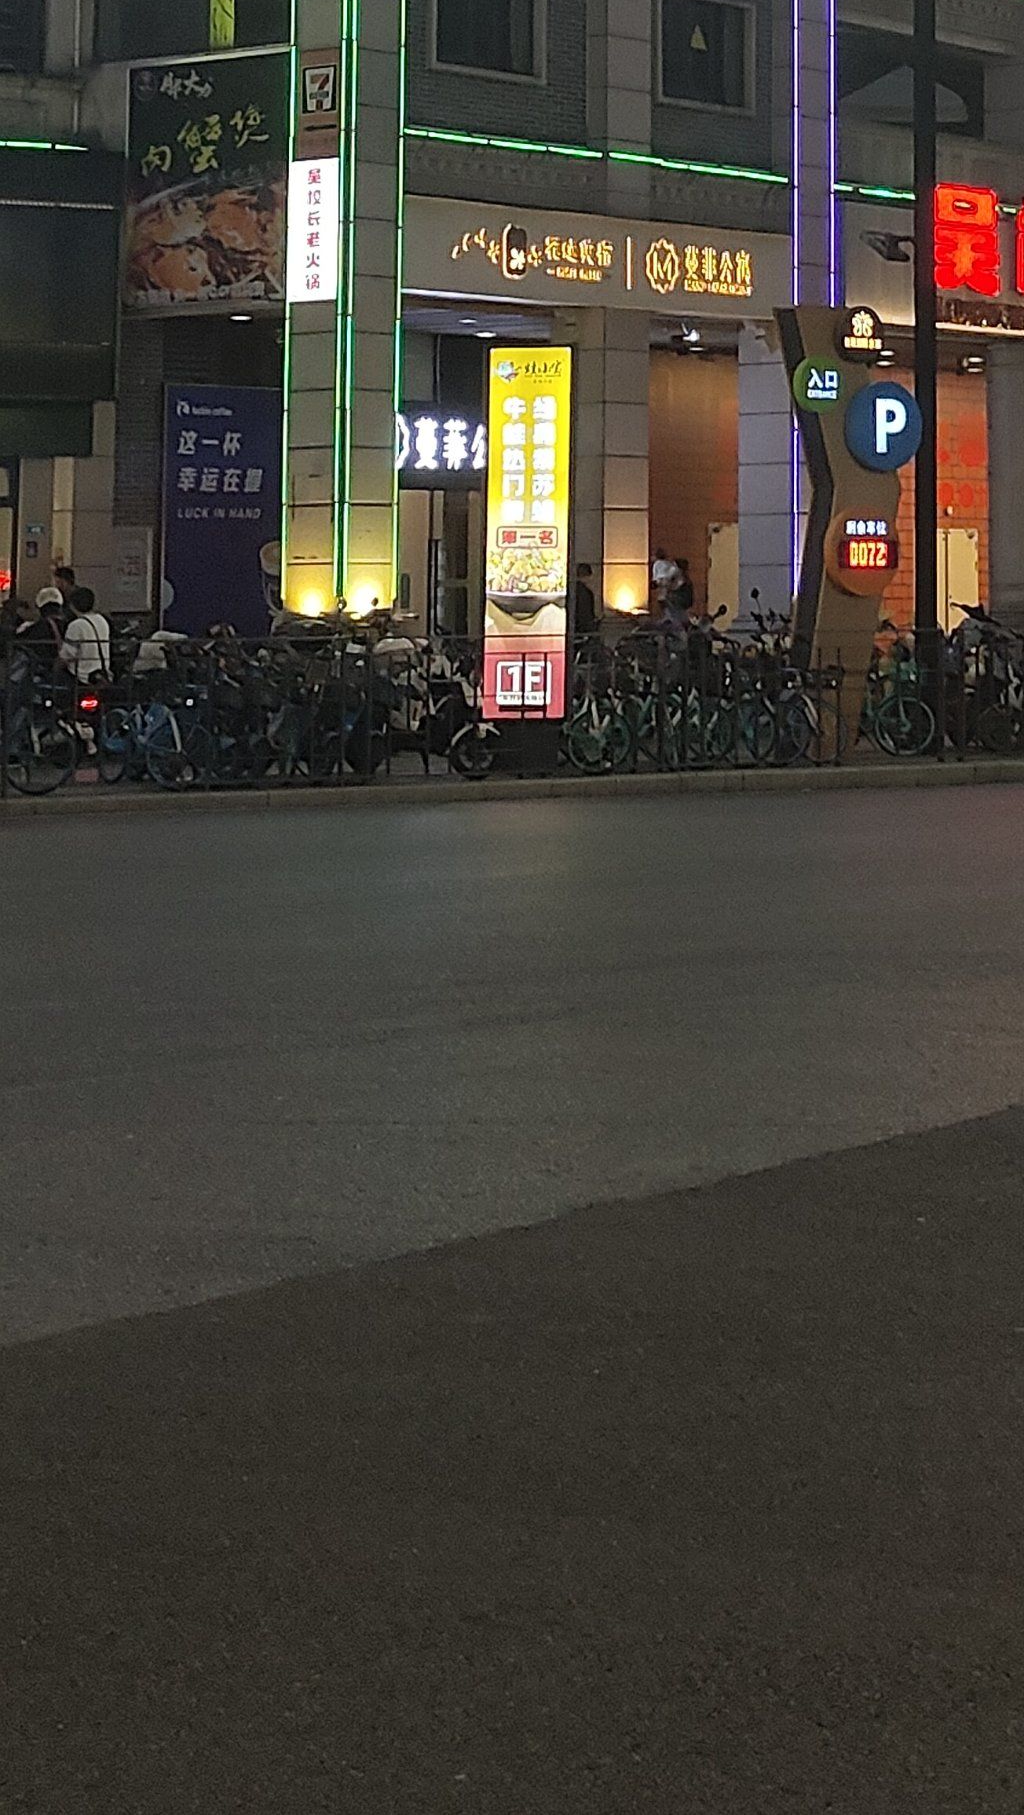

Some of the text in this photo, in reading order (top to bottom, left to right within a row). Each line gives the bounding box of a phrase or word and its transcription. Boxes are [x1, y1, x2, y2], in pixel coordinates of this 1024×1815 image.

[808, 368, 838, 388] 入口
[875, 398, 907, 454] P
[177, 430, 241, 456] 这一杯
[178, 507, 262, 519] LUCK IN HAND
[849, 541, 888, 567] 0072
[507, 666, 543, 693] 1F
